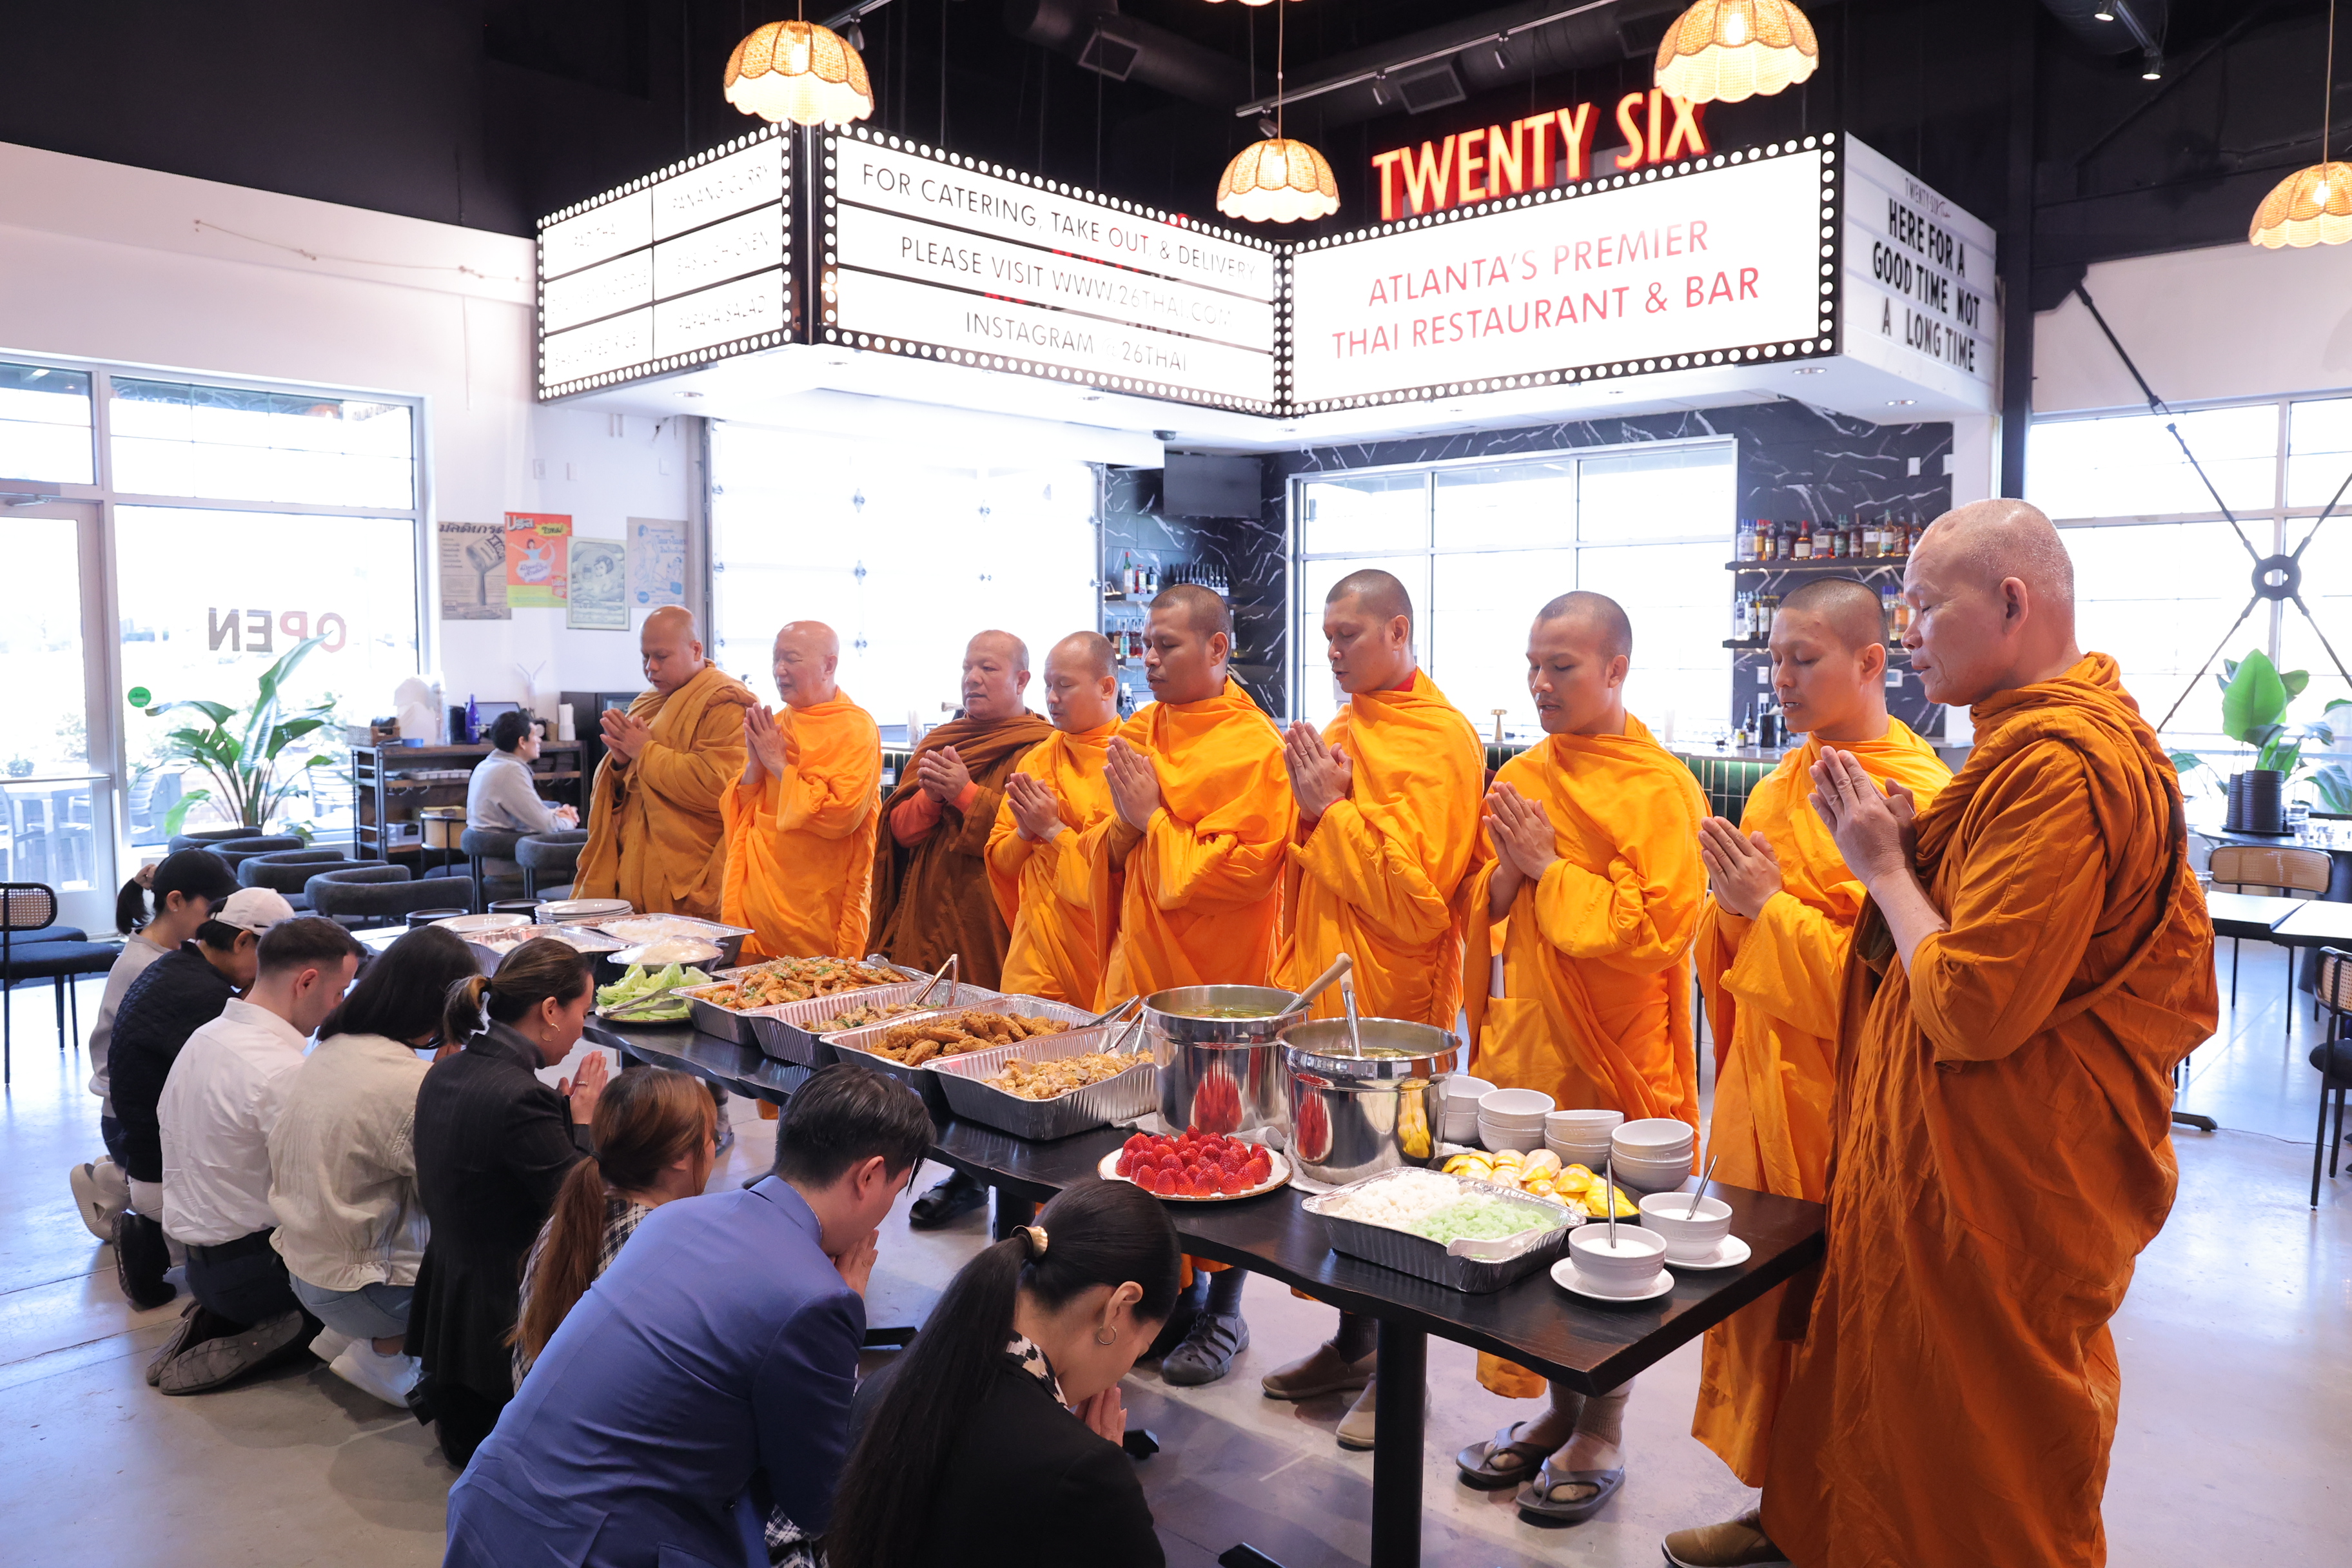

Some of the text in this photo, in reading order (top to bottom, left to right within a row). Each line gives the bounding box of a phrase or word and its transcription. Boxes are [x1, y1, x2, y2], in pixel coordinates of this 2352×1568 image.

[1371, 86, 1709, 221] TWENTY SIX
[863, 162, 1255, 280] FOR CATERING, TAKE OUT, & DELIVERY
[1368, 220, 1709, 307] ATLANTA'S PREMIER
[1888, 197, 1965, 279] HERE FOR A
[901, 236, 1233, 328] PLEASE VISIT WWW.26THAI.COM
[1331, 266, 1759, 359] THAI RESTAURANT & BAR
[1873, 240, 1981, 330] GOOD TIME NOT
[966, 312, 1094, 355] INSTAGRAM
[1882, 297, 1975, 373] A LONG TIME
